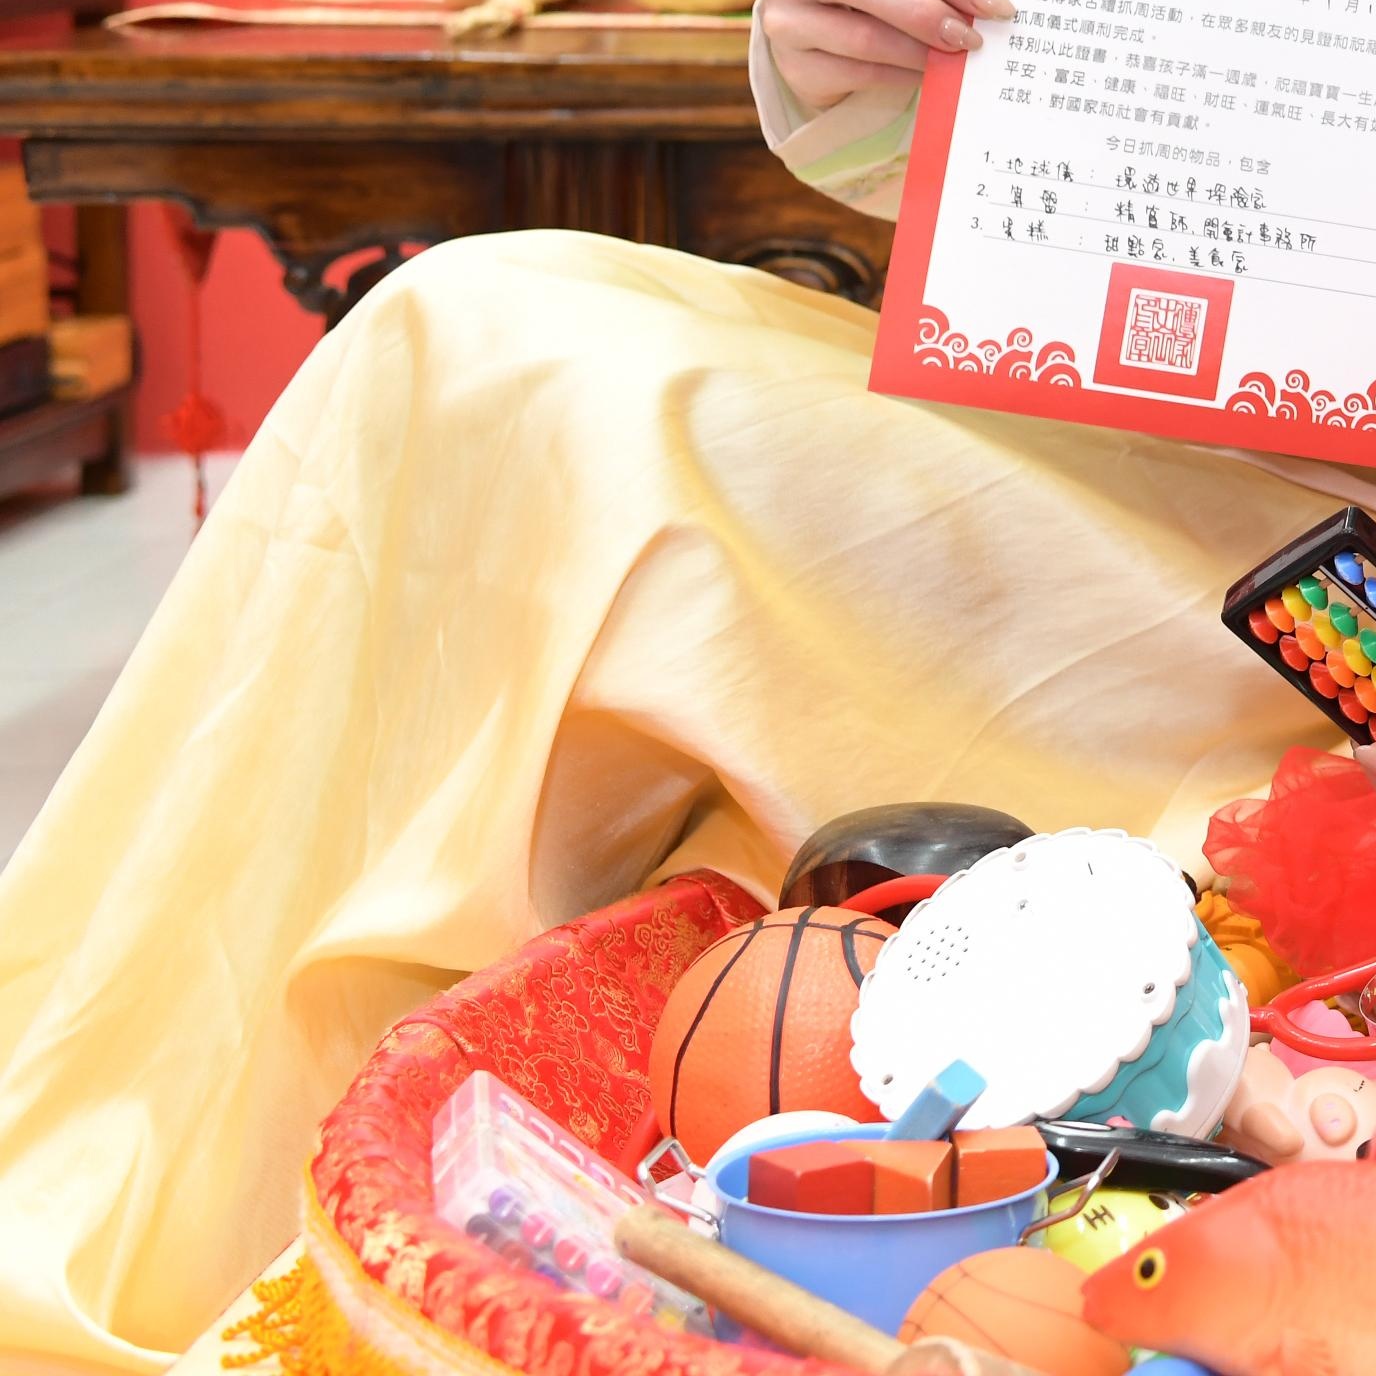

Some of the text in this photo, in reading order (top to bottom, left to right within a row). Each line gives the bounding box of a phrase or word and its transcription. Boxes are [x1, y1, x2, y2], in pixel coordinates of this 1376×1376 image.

[984, 151, 995, 164] 1.
[1007, 158, 1074, 182] 地球儀
[977, 184, 989, 198] 2.
[970, 217, 983, 231] 3.
